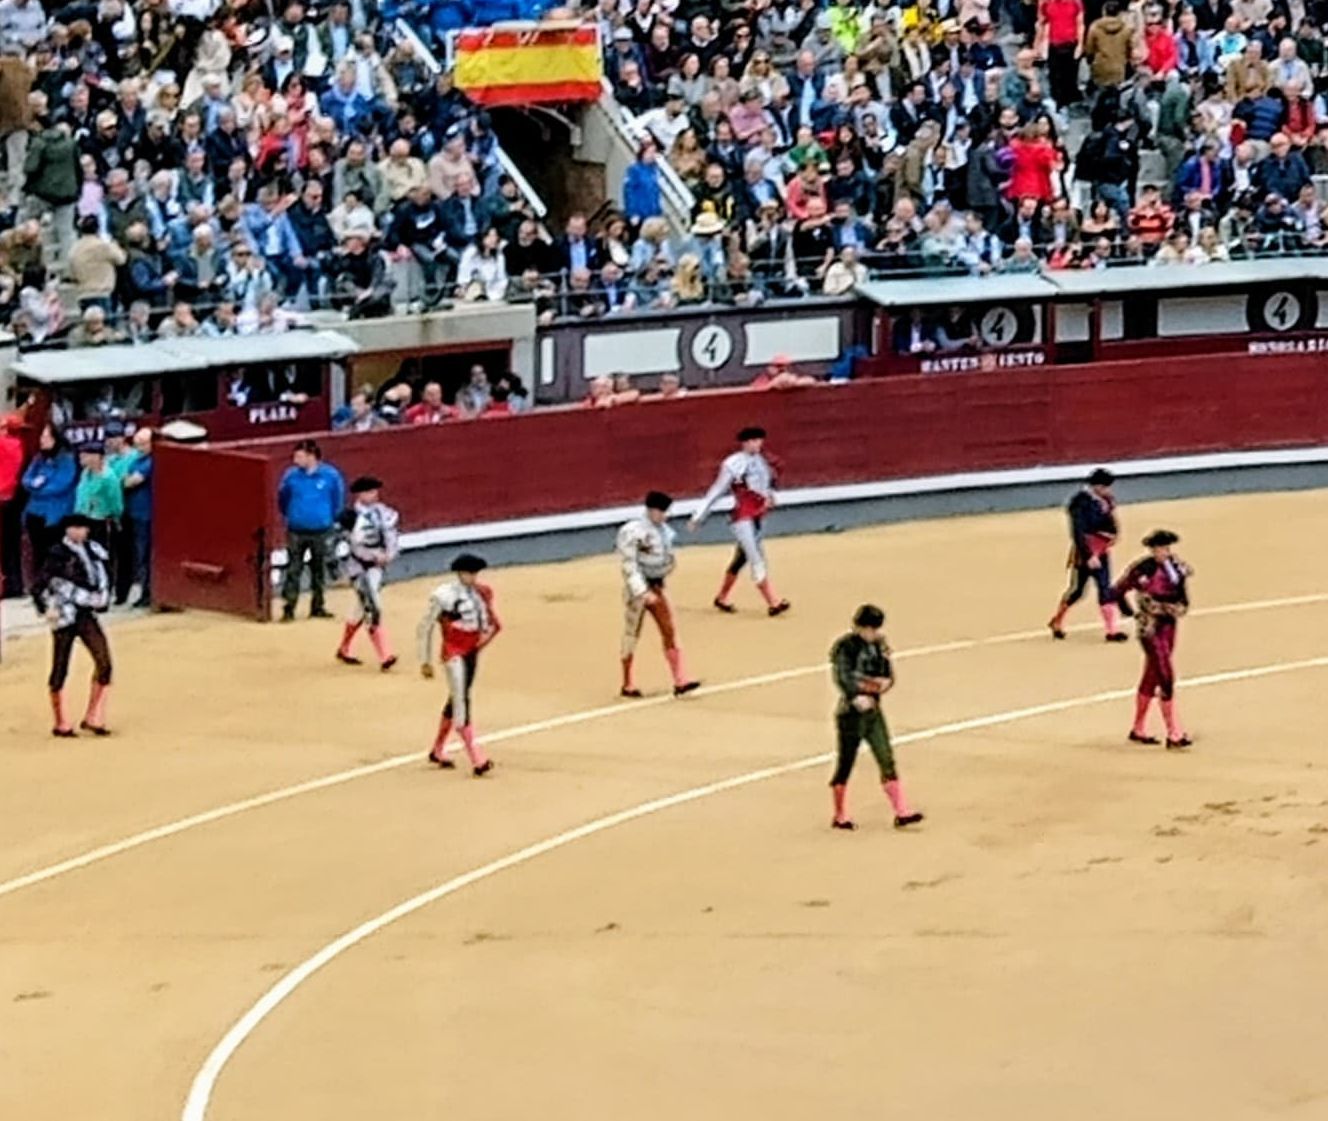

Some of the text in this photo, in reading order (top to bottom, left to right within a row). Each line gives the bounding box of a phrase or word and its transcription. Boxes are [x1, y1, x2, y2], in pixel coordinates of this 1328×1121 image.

[1271, 294, 1290, 326] 4
[988, 311, 1006, 342] 4
[701, 332, 718, 363] 4
